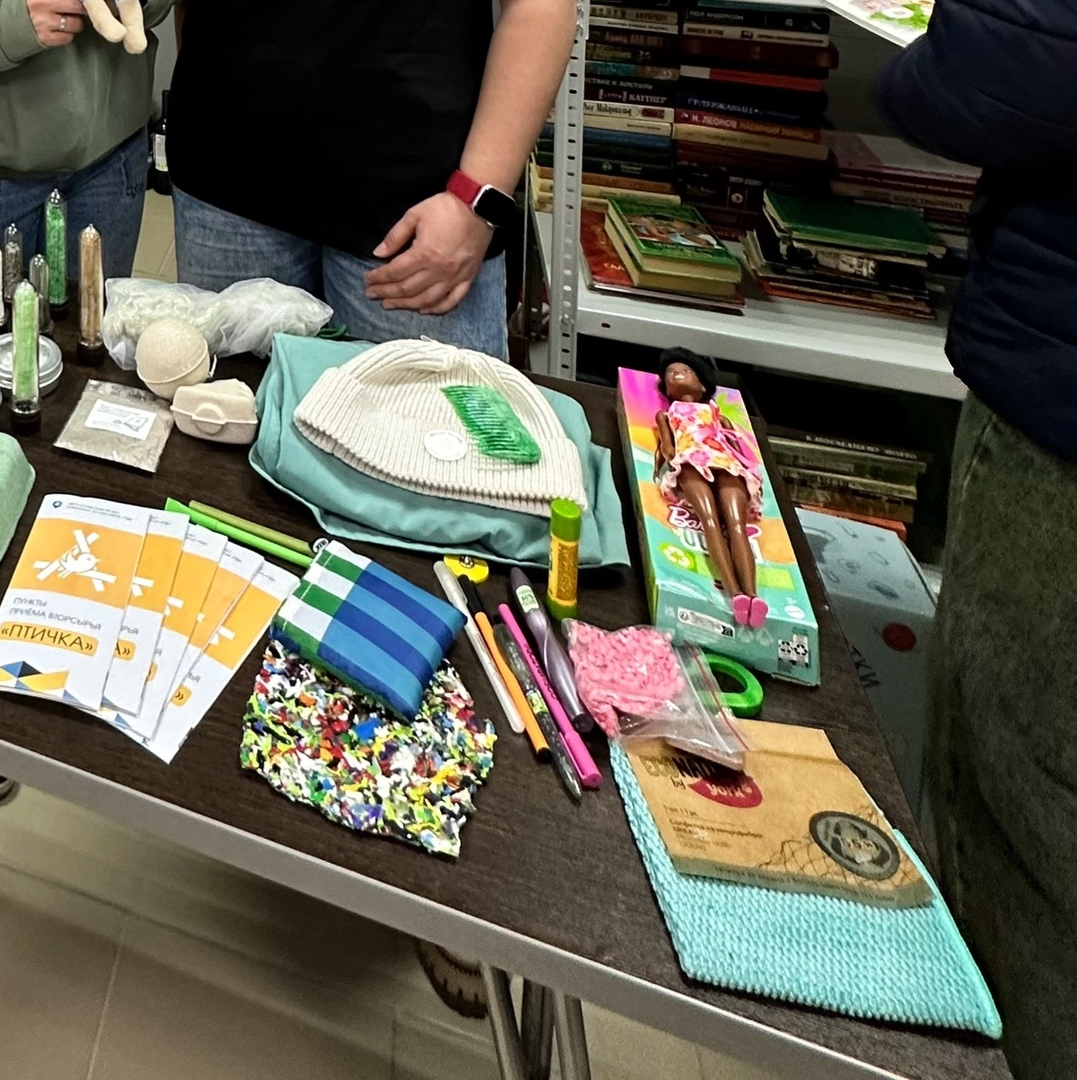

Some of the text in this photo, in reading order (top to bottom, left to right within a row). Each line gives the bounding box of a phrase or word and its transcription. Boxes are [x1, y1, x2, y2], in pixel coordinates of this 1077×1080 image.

[13, 597, 47, 607] ПУНКТЫ
[9, 607, 102, 631] ПРИЁМА ВТОРСЫРЬЯ
[1, 624, 93, 651] «ПТИЧКА»
